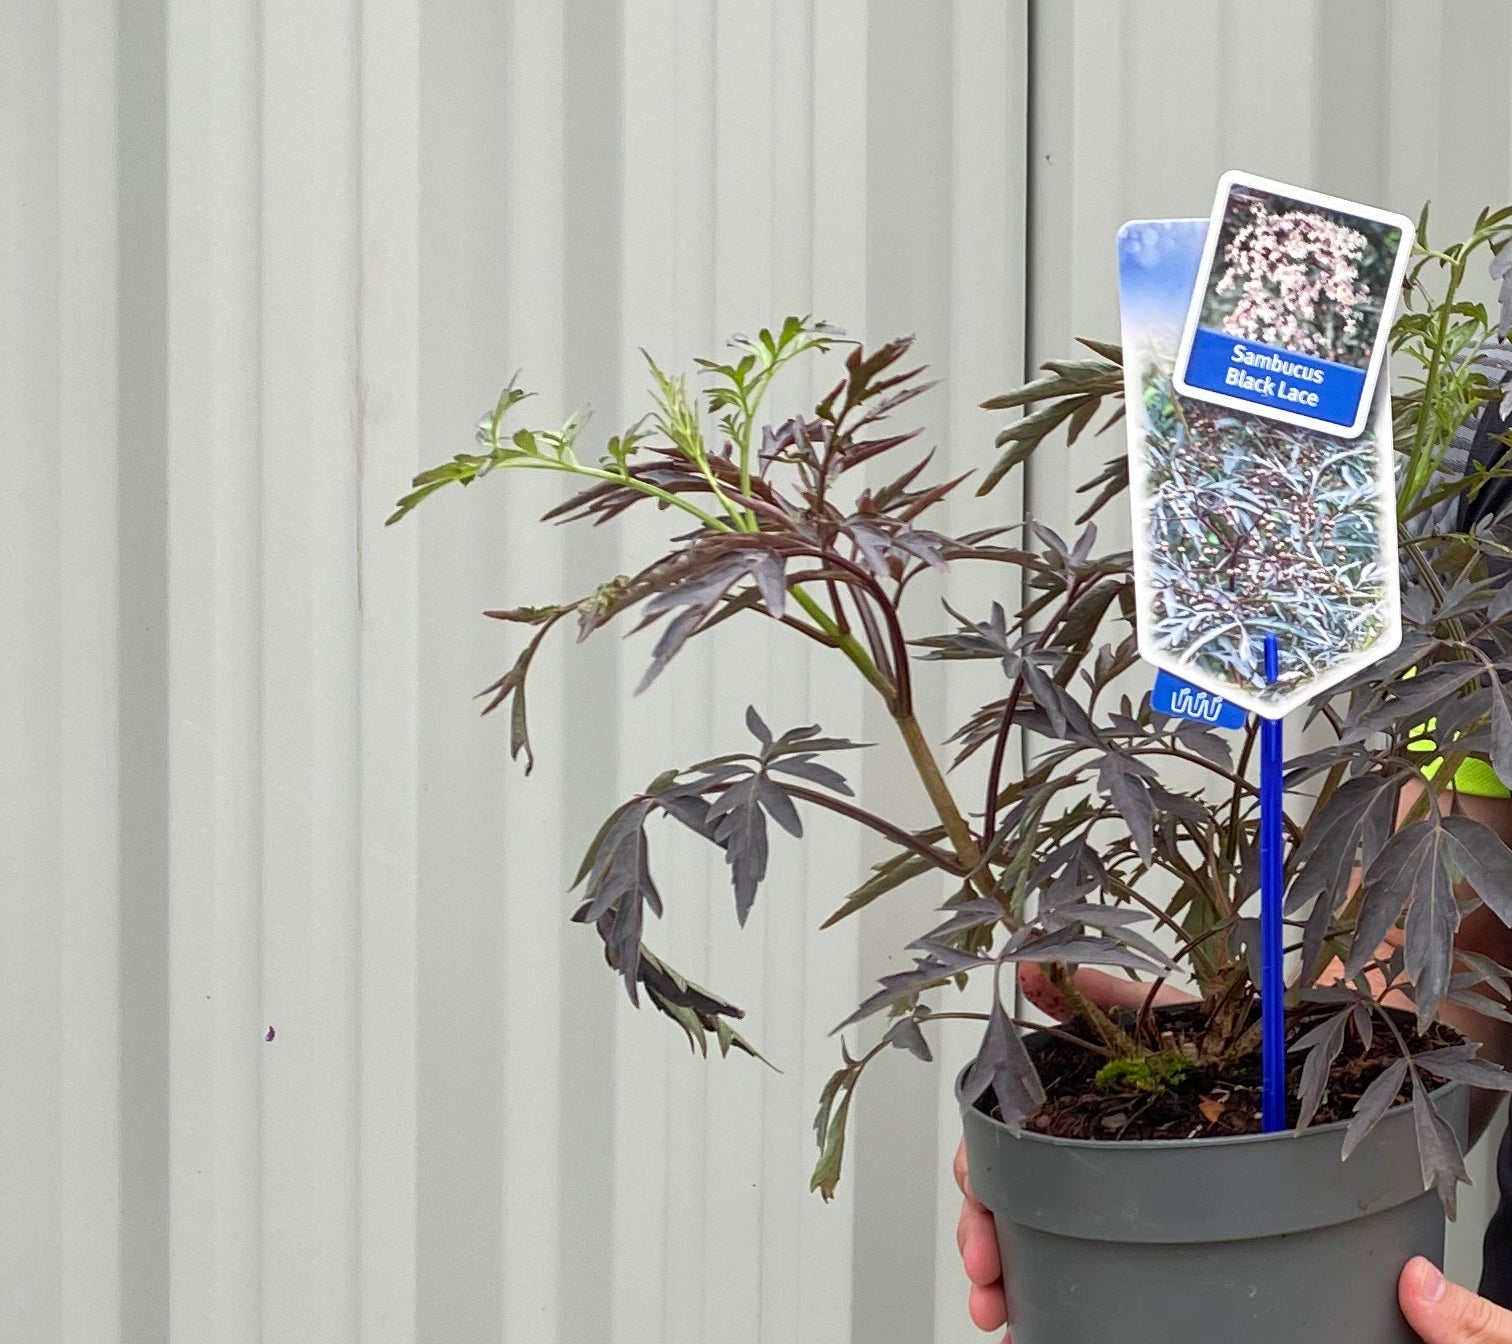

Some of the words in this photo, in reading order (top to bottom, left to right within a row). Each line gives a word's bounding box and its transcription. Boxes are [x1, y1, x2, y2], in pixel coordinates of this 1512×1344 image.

[1230, 344, 1325, 384] Sambucus
[1225, 367, 1276, 396] Black
[1277, 380, 1320, 408] Lace
